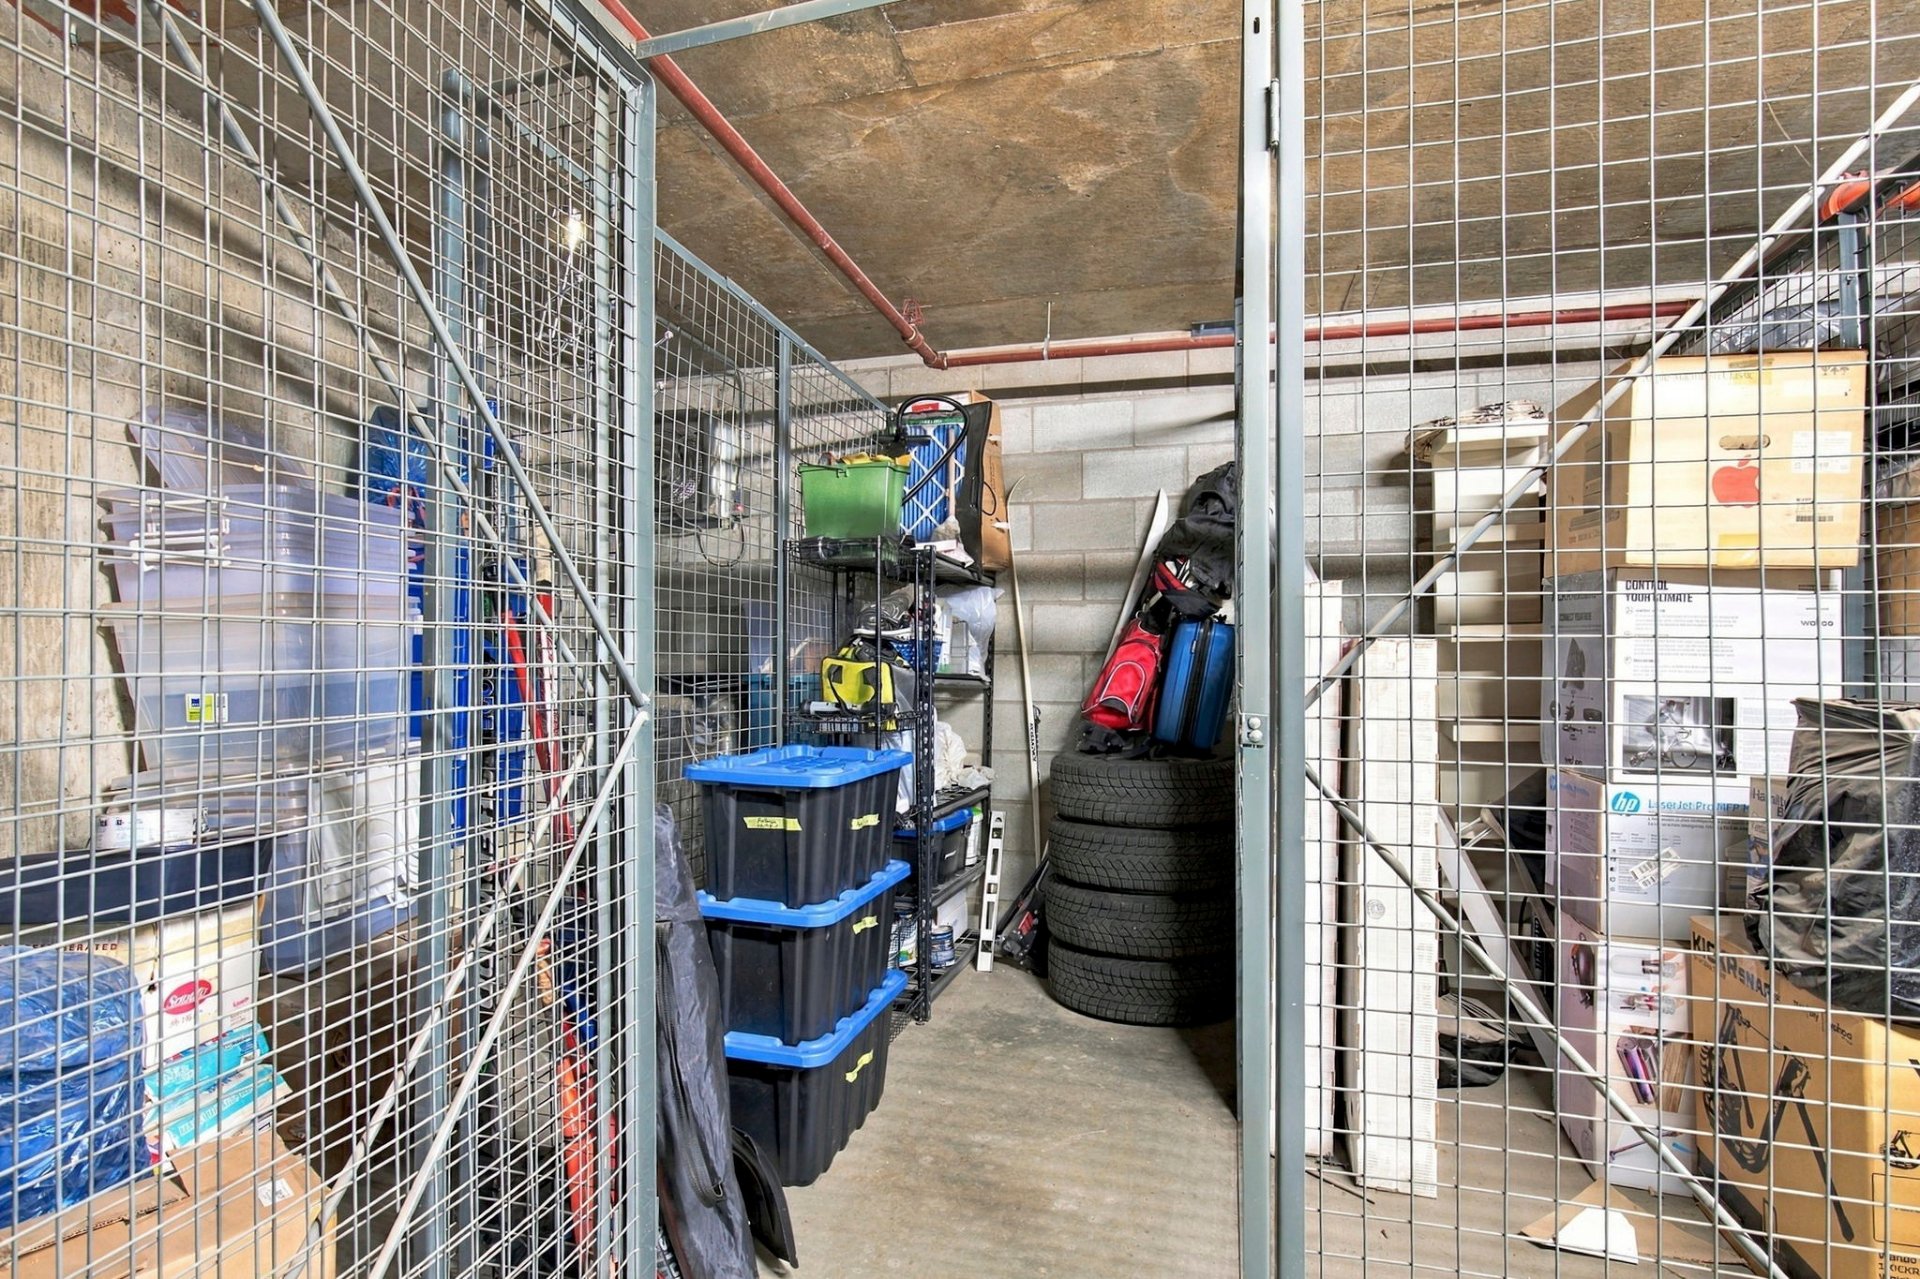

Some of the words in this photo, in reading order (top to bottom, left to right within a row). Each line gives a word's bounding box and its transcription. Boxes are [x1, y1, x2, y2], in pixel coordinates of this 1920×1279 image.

[1625, 593, 1651, 603] YOUR
[1615, 791, 1638, 815] hp
[1648, 798, 1692, 810] LserJet
